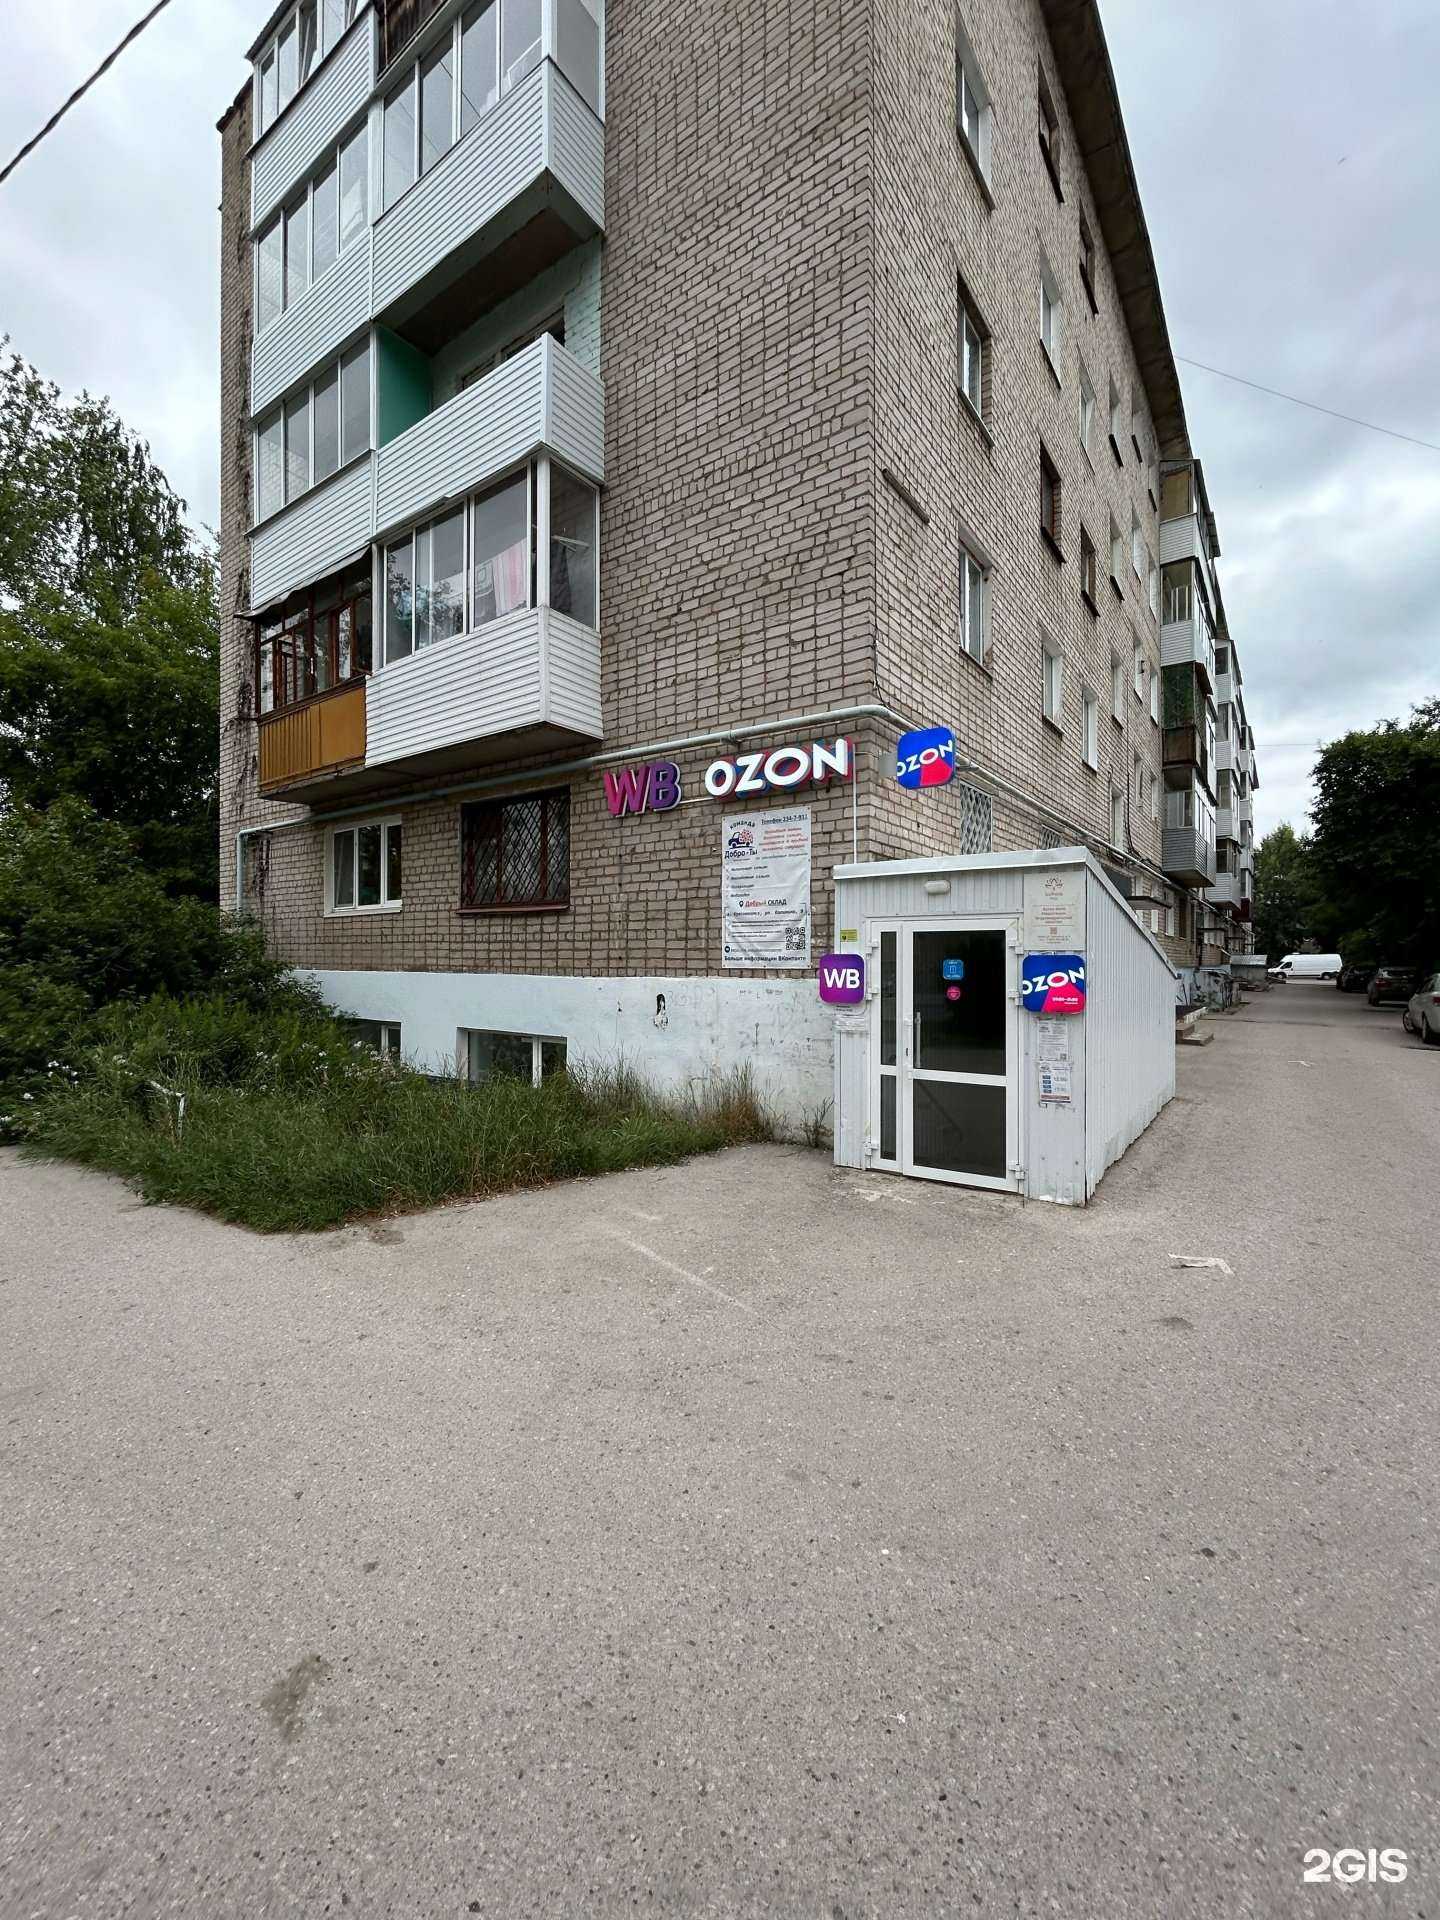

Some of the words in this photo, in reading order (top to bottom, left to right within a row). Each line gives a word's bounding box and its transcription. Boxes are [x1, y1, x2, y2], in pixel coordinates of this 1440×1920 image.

[704, 738, 850, 797] OZON
[896, 739, 953, 777] OZON
[603, 760, 681, 817] WB
[823, 968, 861, 989] WB
[1022, 966, 1085, 995] OZON
